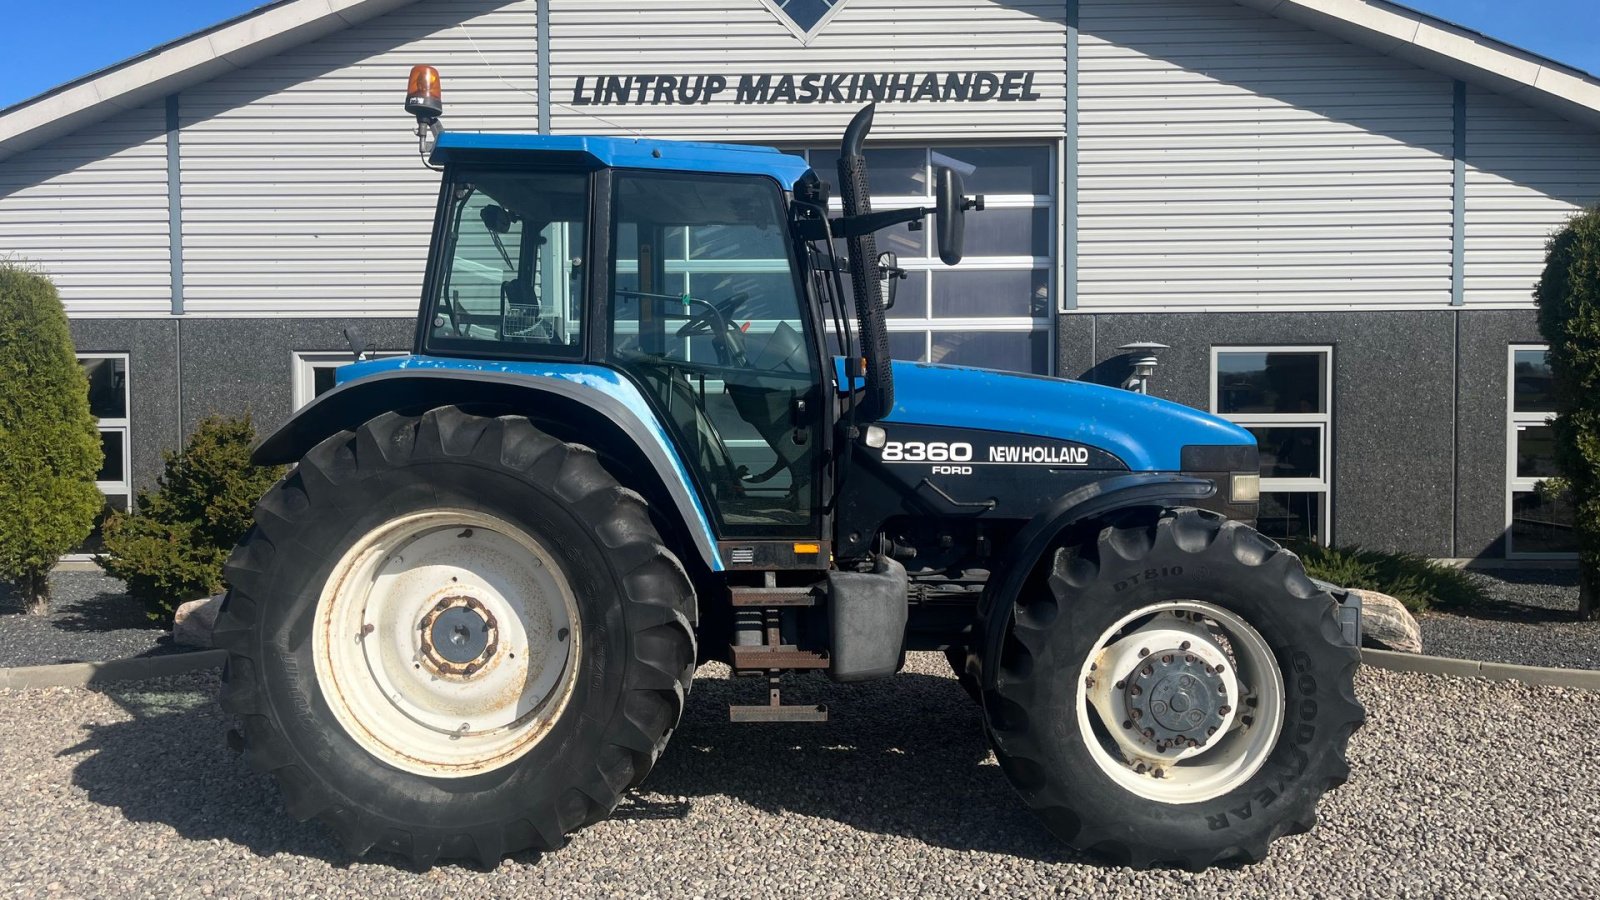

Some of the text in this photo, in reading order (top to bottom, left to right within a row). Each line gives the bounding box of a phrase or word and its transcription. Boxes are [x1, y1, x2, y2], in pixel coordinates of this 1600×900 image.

[571, 72, 1042, 105] LINTRUP MASKINHANDEL
[881, 441, 973, 462] 8360
[931, 465, 973, 475] FORD
[1113, 566, 1184, 592] DT810
